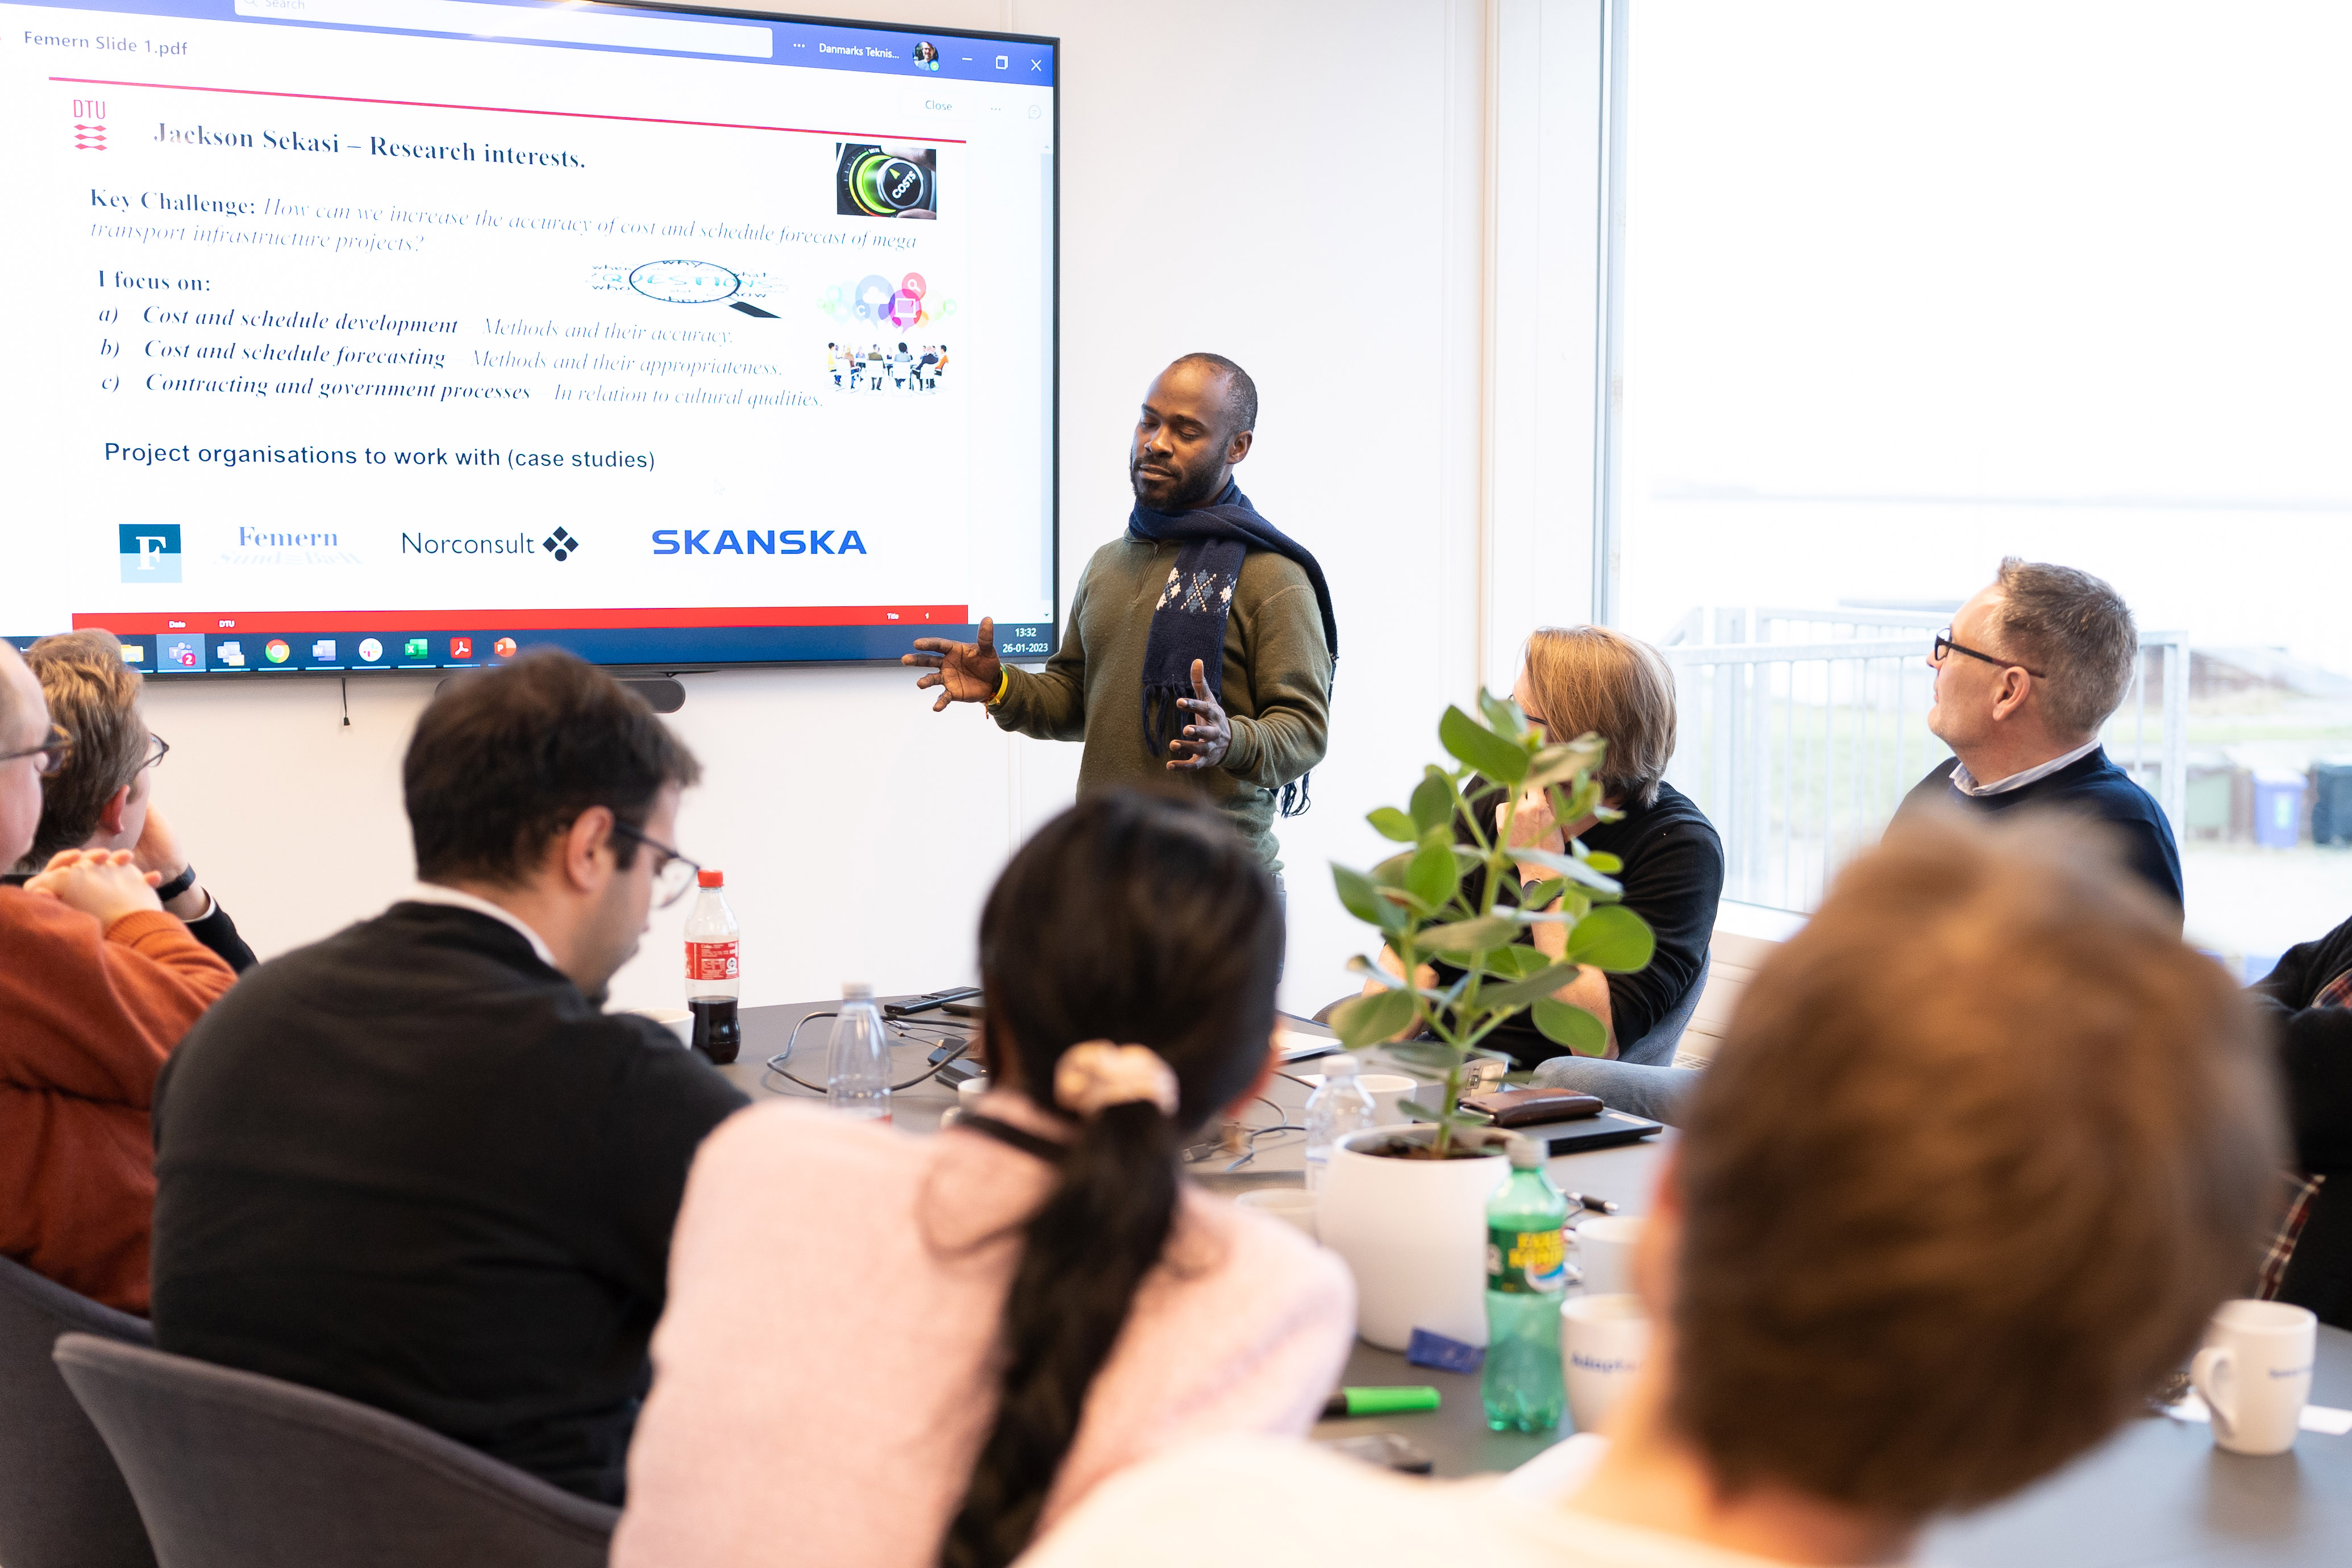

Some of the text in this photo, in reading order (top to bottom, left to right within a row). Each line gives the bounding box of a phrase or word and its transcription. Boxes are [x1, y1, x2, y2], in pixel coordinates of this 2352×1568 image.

[265, 0, 305, 10] Search
[24, 31, 188, 57] Femern Slide 1.pdf
[818, 43, 864, 56] Danmarks
[73, 99, 106, 119] DTU
[925, 100, 952, 111] Close
[153, 122, 253, 148] Jackson
[263, 129, 339, 153] Sekasi
[370, 136, 476, 161] Research
[484, 143, 585, 169] interests.
[892, 170, 916, 199] COSTS
[91, 189, 916, 251] Key Challenge: How can we increase the accuracy of cost and schedule forecast of mega
[91, 223, 424, 254] transport infrastructure projects?
[98, 270, 210, 291] I focus on:
[602, 273, 773, 289] QUESTIONS
[99, 306, 732, 346] a) Cost and schedule development Methods and their accuracy.
[101, 338, 782, 377] b) Cost and schedule forecasting Methods and their appropriateness.
[102, 373, 823, 410] c) Contracting and government processes In relation to cultural qualities.
[105, 442, 655, 472] Project organisations to work with (case studies)
[239, 526, 338, 547] Femern
[402, 532, 535, 554] Norconsult
[651, 529, 868, 555] SKANSKA
[135, 536, 166, 570] F
[218, 619, 235, 628] DTU
[1015, 627, 1036, 637] 13:32
[1002, 643, 1048, 653] 26-01-2023
[185, 654, 193, 665] 2
